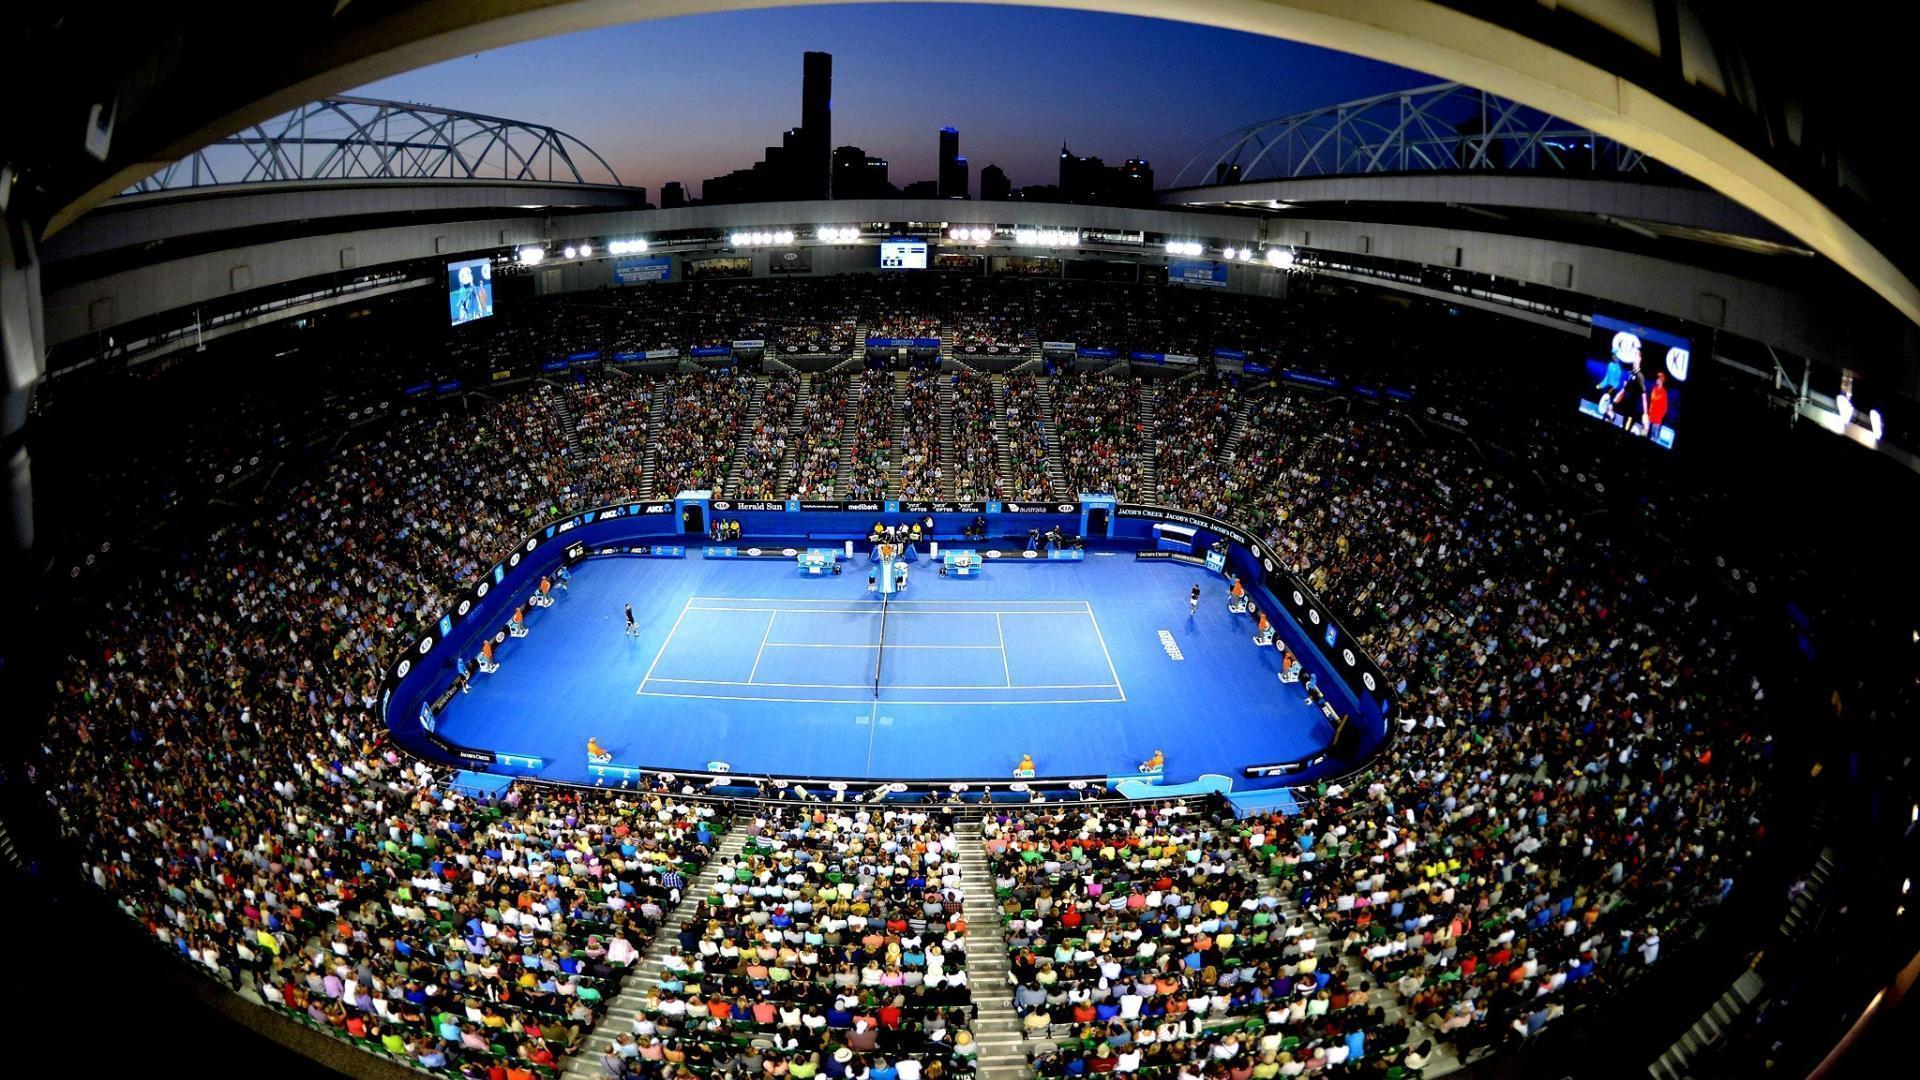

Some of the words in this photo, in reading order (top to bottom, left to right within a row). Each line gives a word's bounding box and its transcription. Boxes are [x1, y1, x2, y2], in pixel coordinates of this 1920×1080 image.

[600, 510, 617, 520] ANZ
[646, 505, 664, 513] ANZ
[559, 520, 575, 533] ANZ
[1165, 512, 1188, 522] JACOB'S
[1190, 517, 1208, 528] CREEK
[1210, 524, 1229, 535] JACOB'S
[1230, 531, 1245, 544] CREEK
